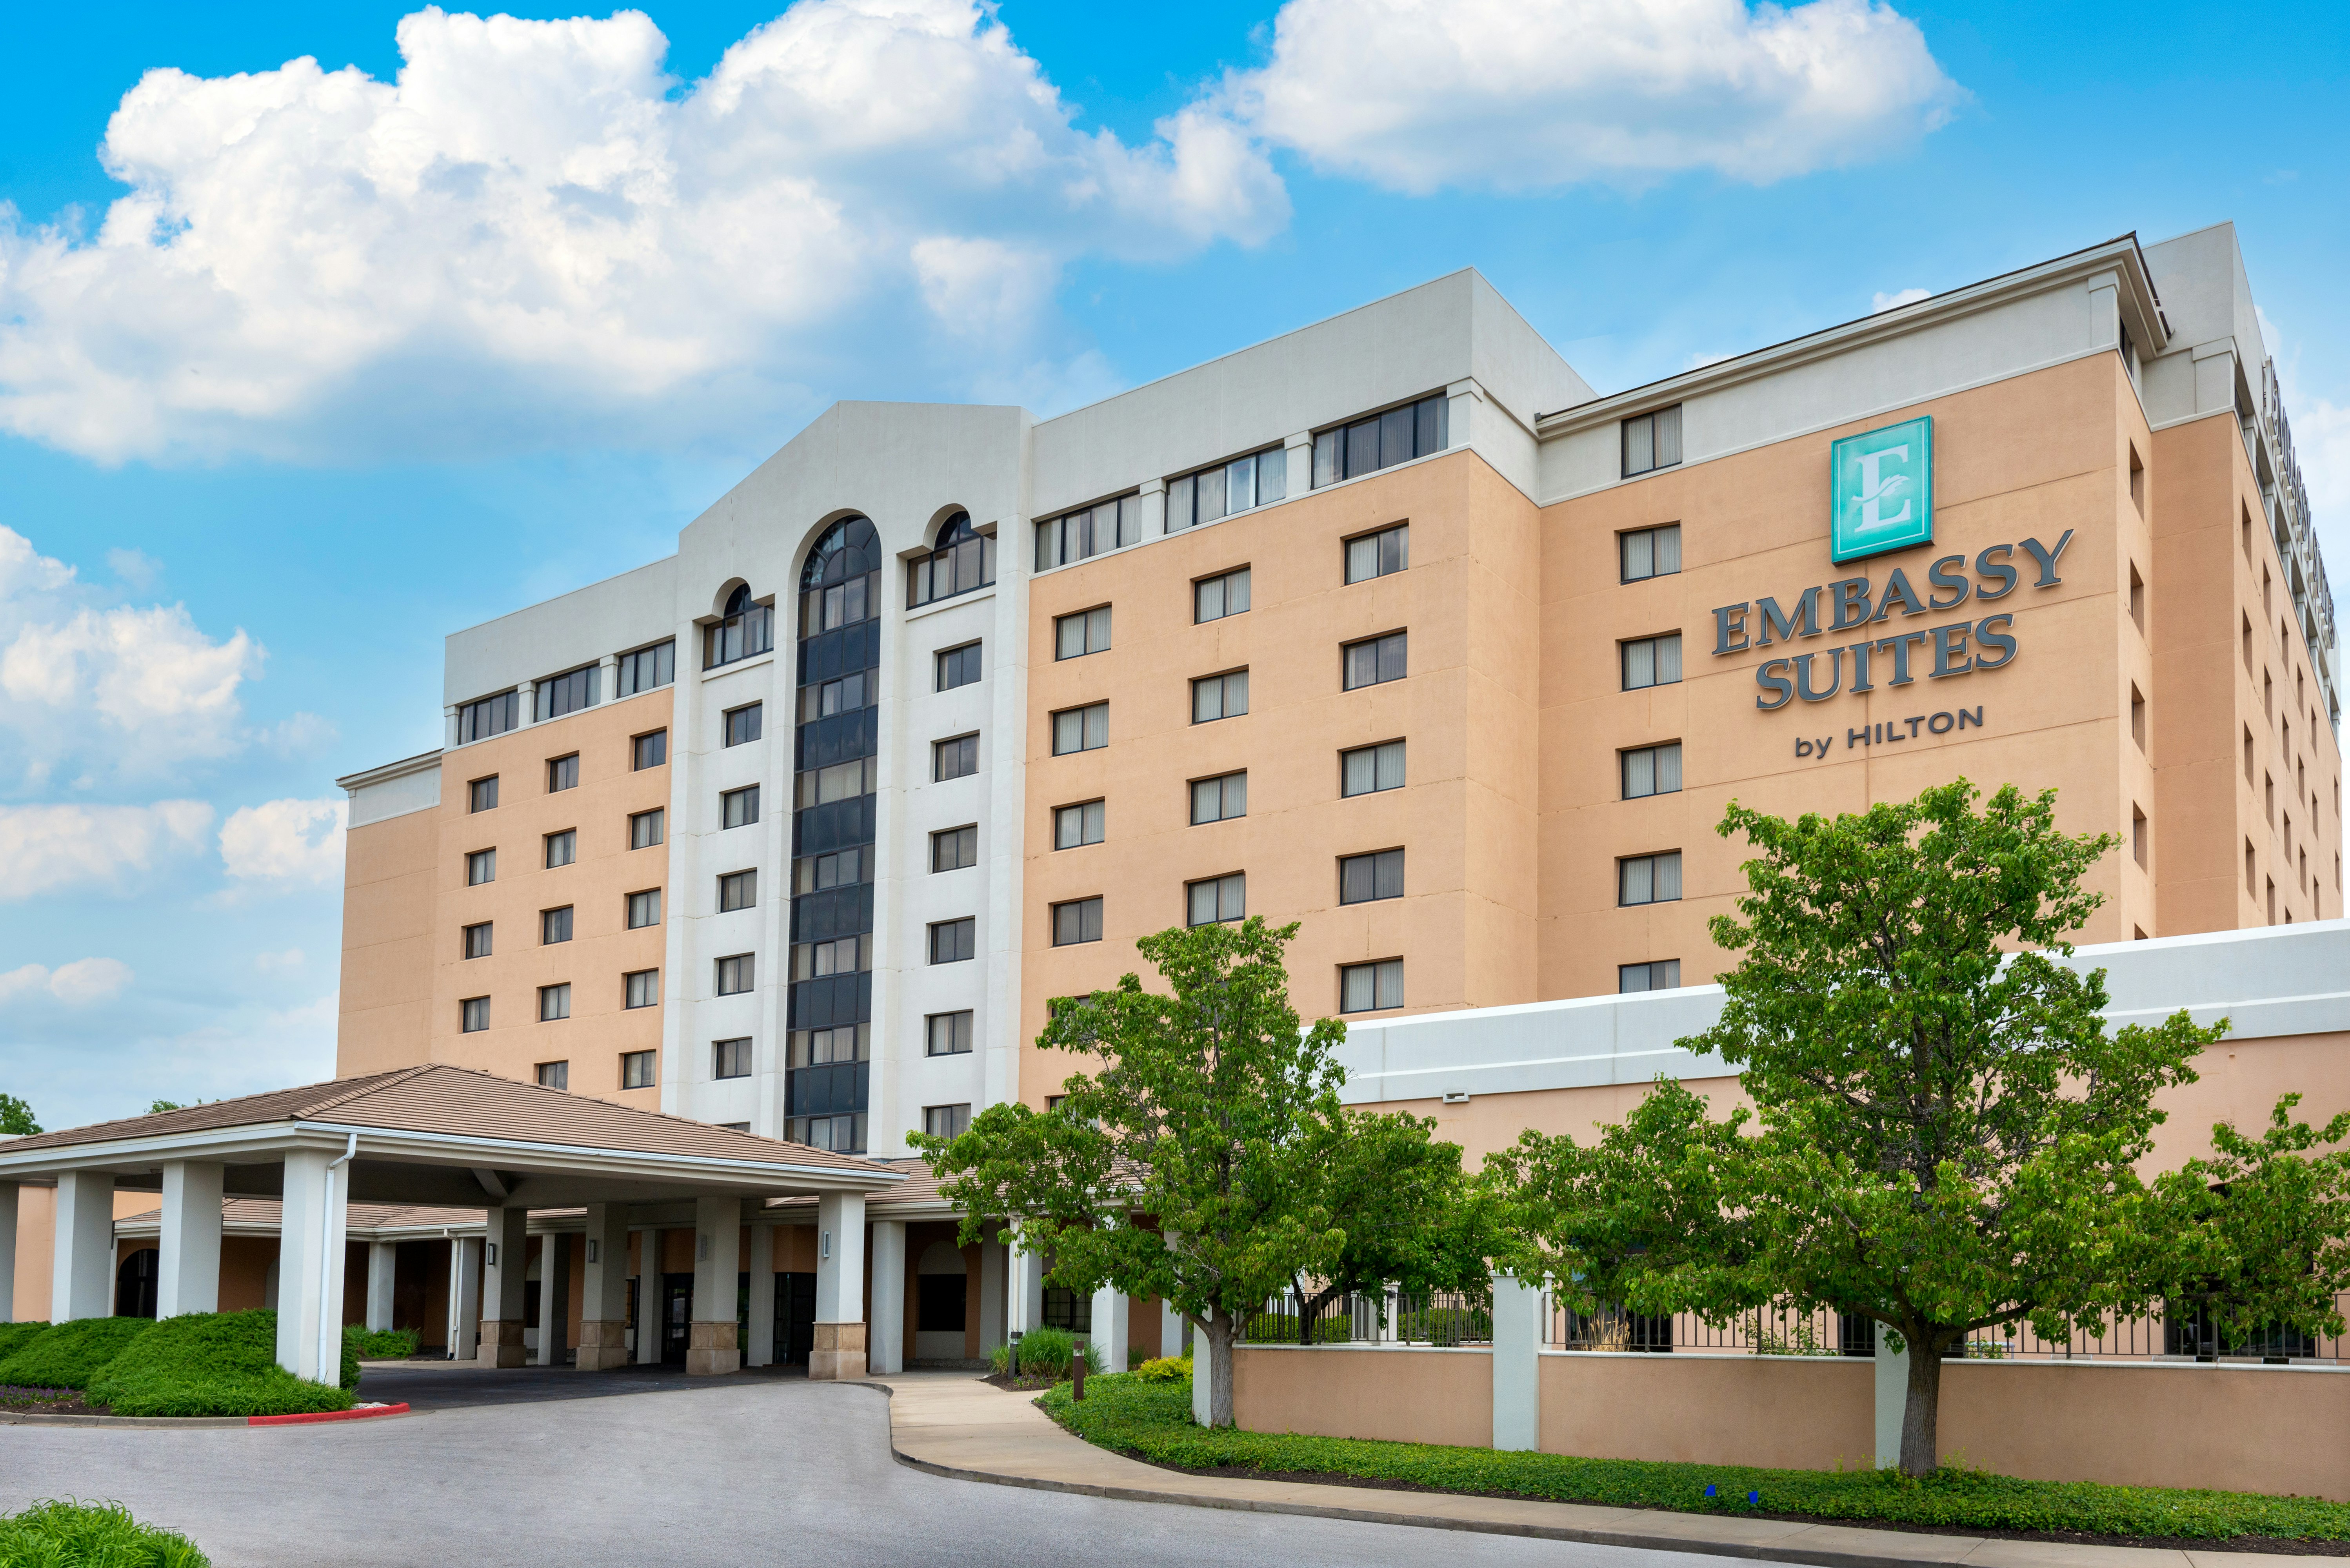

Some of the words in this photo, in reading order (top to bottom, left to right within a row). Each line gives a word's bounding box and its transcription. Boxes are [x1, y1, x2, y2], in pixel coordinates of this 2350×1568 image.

[1850, 443, 1911, 534] E
[2268, 356, 2311, 561] EMBASSY
[2310, 527, 2335, 649] SUITES
[1712, 529, 2074, 655] EMBASSY
[1756, 614, 2018, 710] SUITES
[1796, 737, 1832, 759] by
[1847, 706, 1983, 748] HILTON
